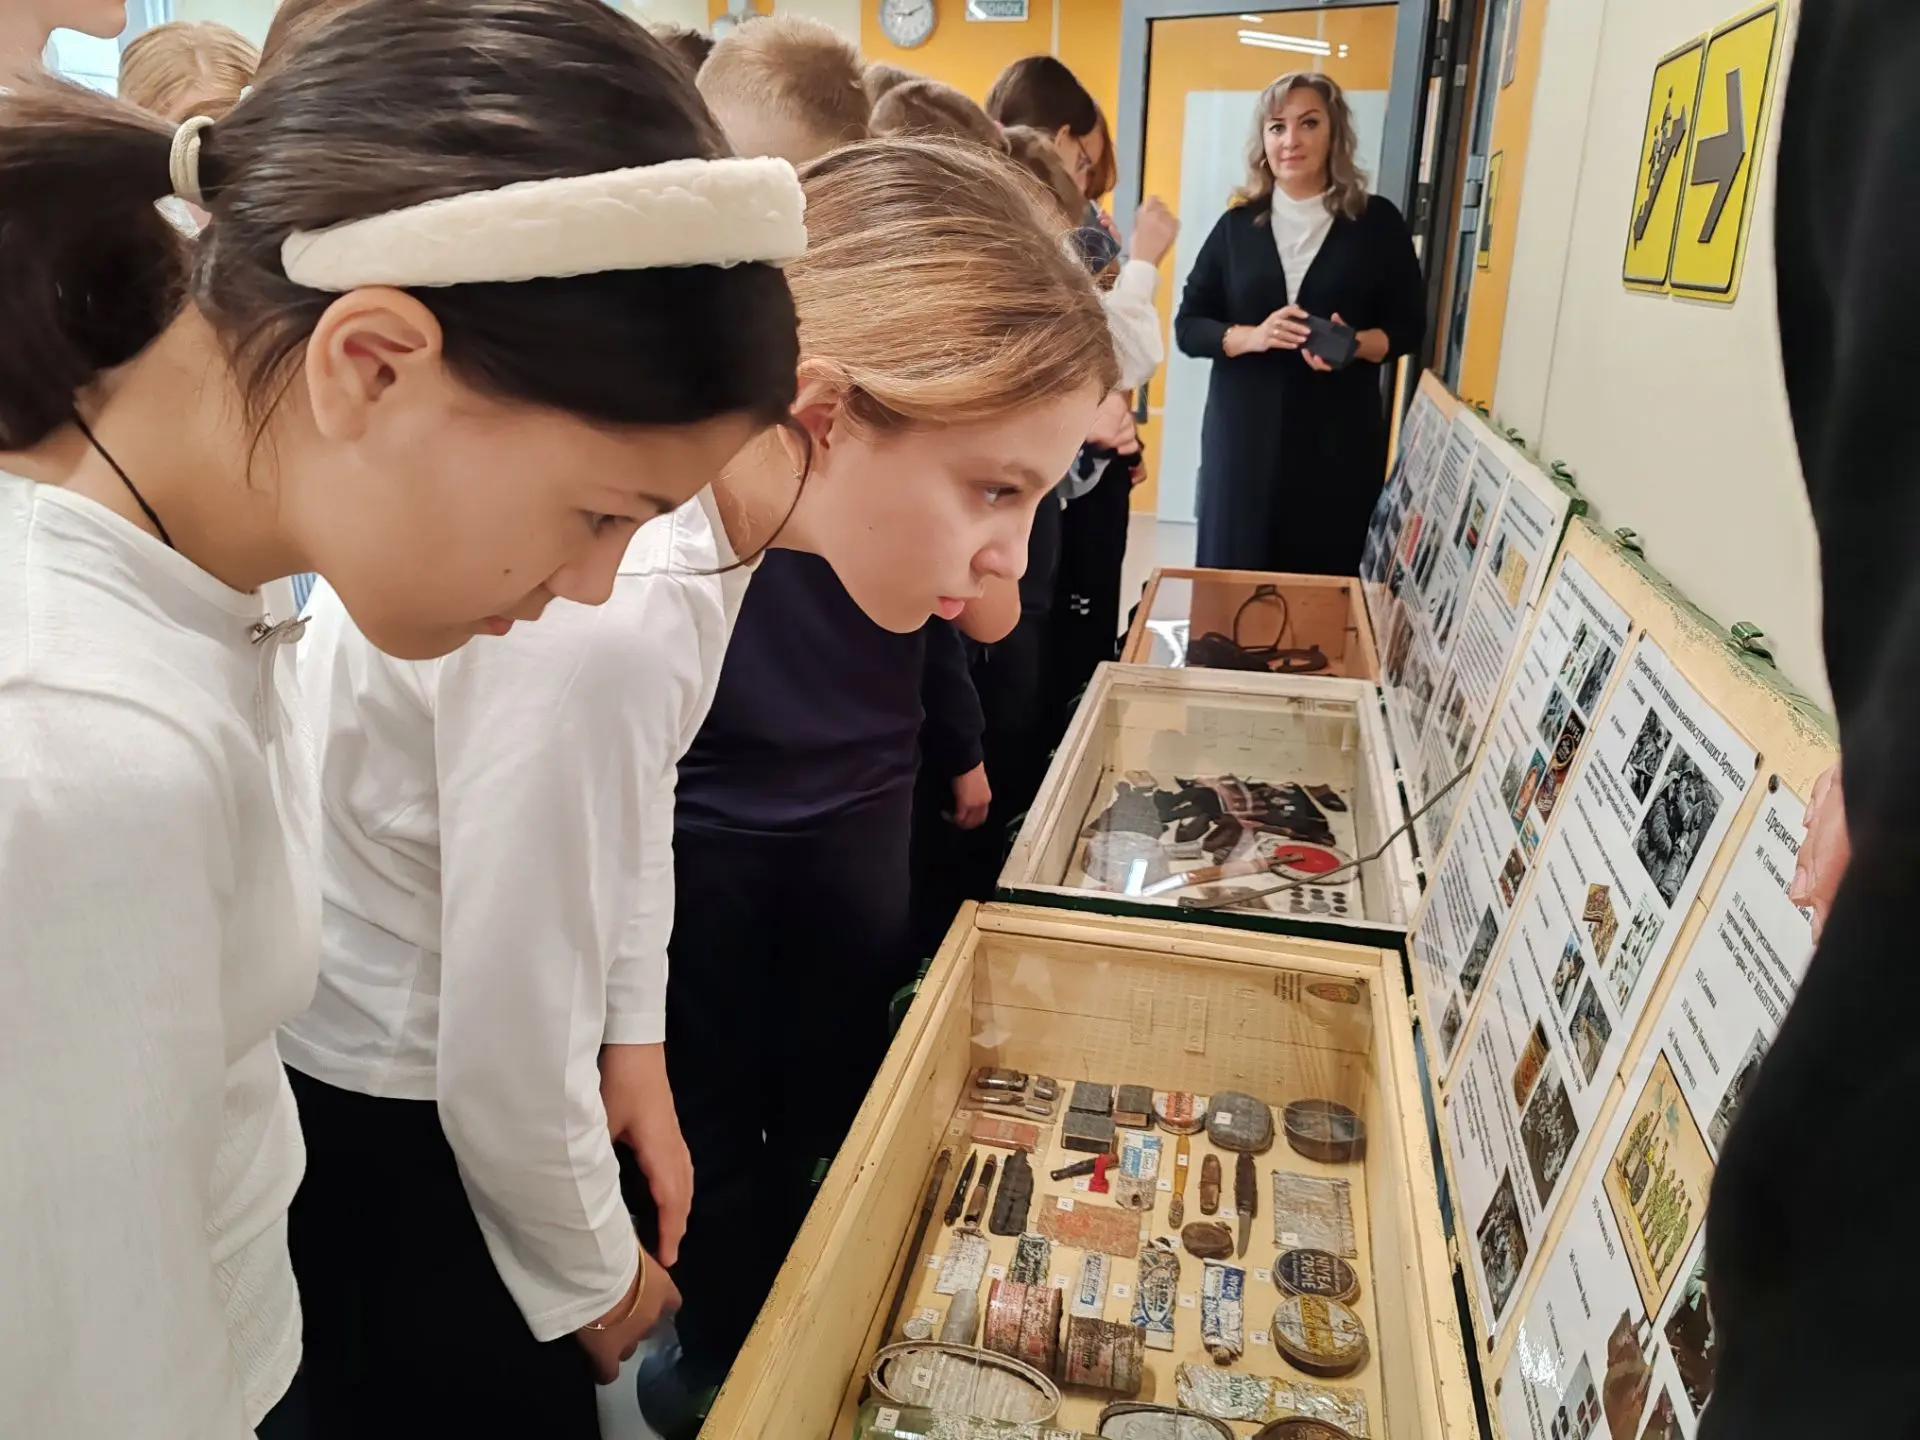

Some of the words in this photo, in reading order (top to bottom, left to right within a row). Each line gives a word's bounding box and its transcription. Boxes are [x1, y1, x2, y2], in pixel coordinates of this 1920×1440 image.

[1763, 806, 1802, 859] Предметы
[1300, 1254, 1316, 1289] CREME
[1315, 1255, 1332, 1290] NIVEA
